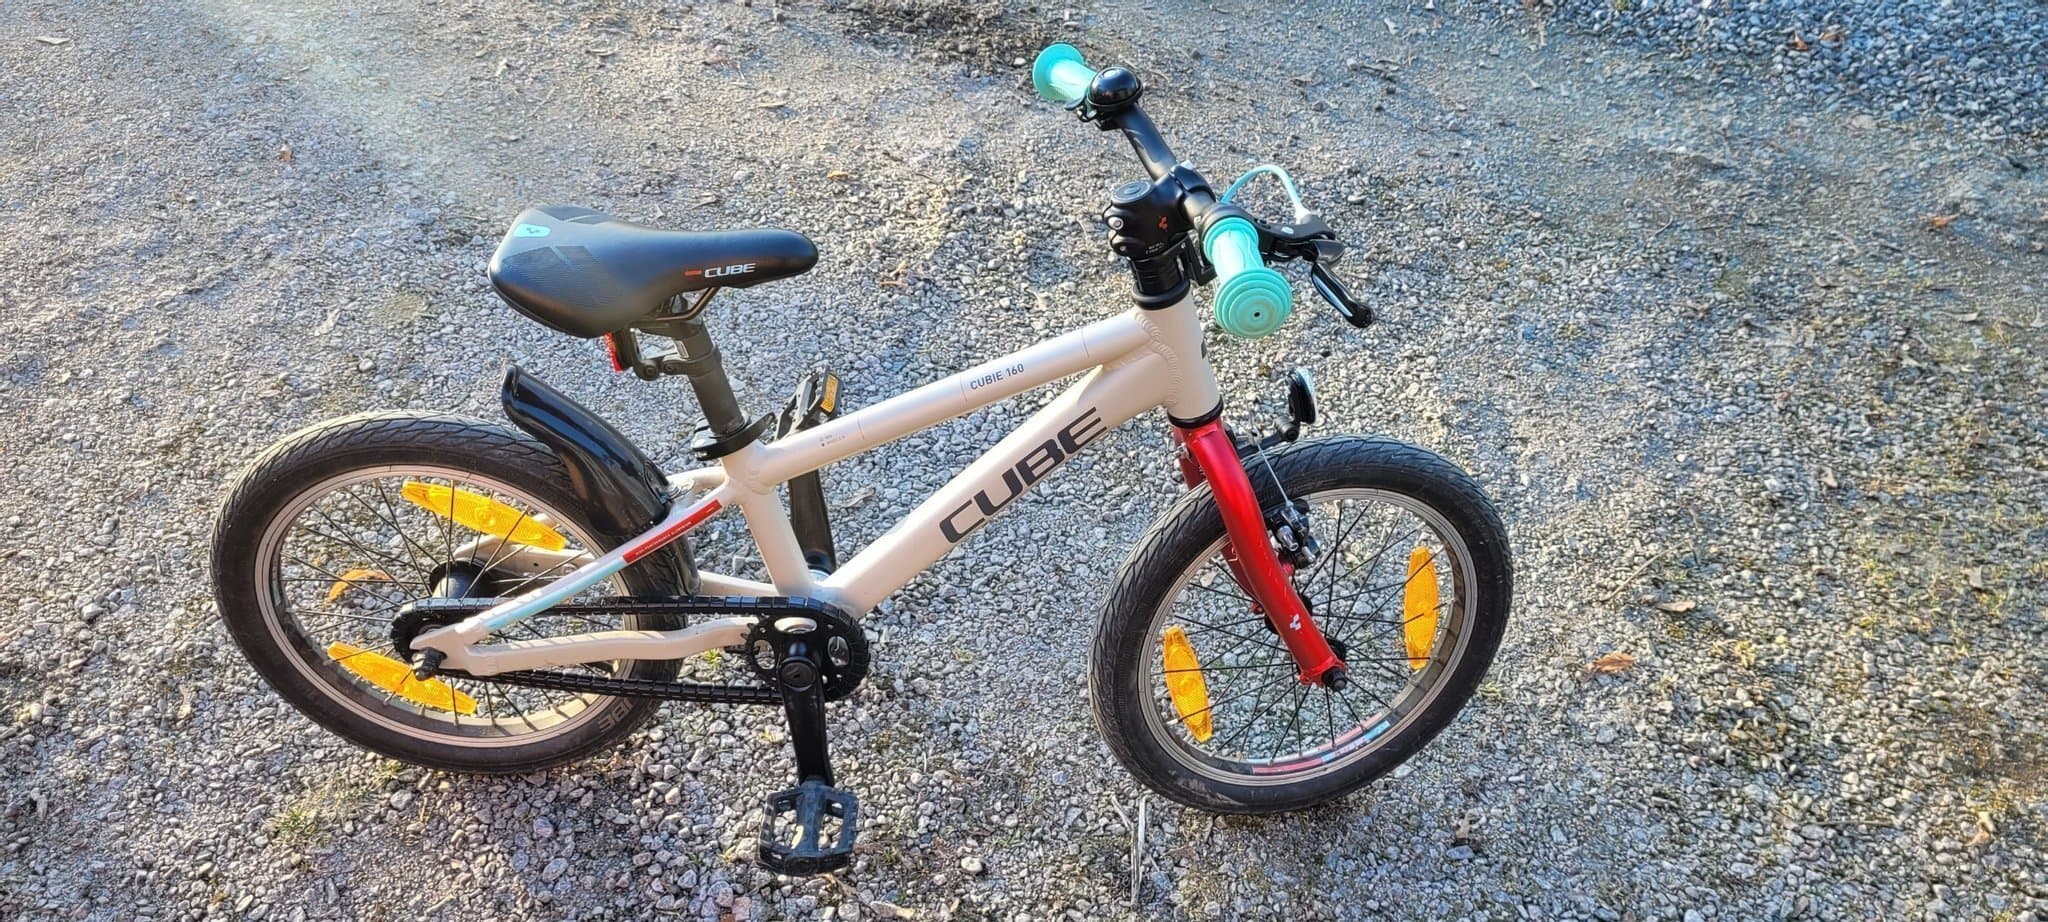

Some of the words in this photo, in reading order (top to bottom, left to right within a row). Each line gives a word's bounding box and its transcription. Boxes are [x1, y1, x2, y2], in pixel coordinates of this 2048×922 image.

[704, 263, 756, 278] CUBE
[970, 370, 1004, 390] CUBIE
[1006, 363, 1025, 377] 160
[939, 406, 1107, 544] CUBE
